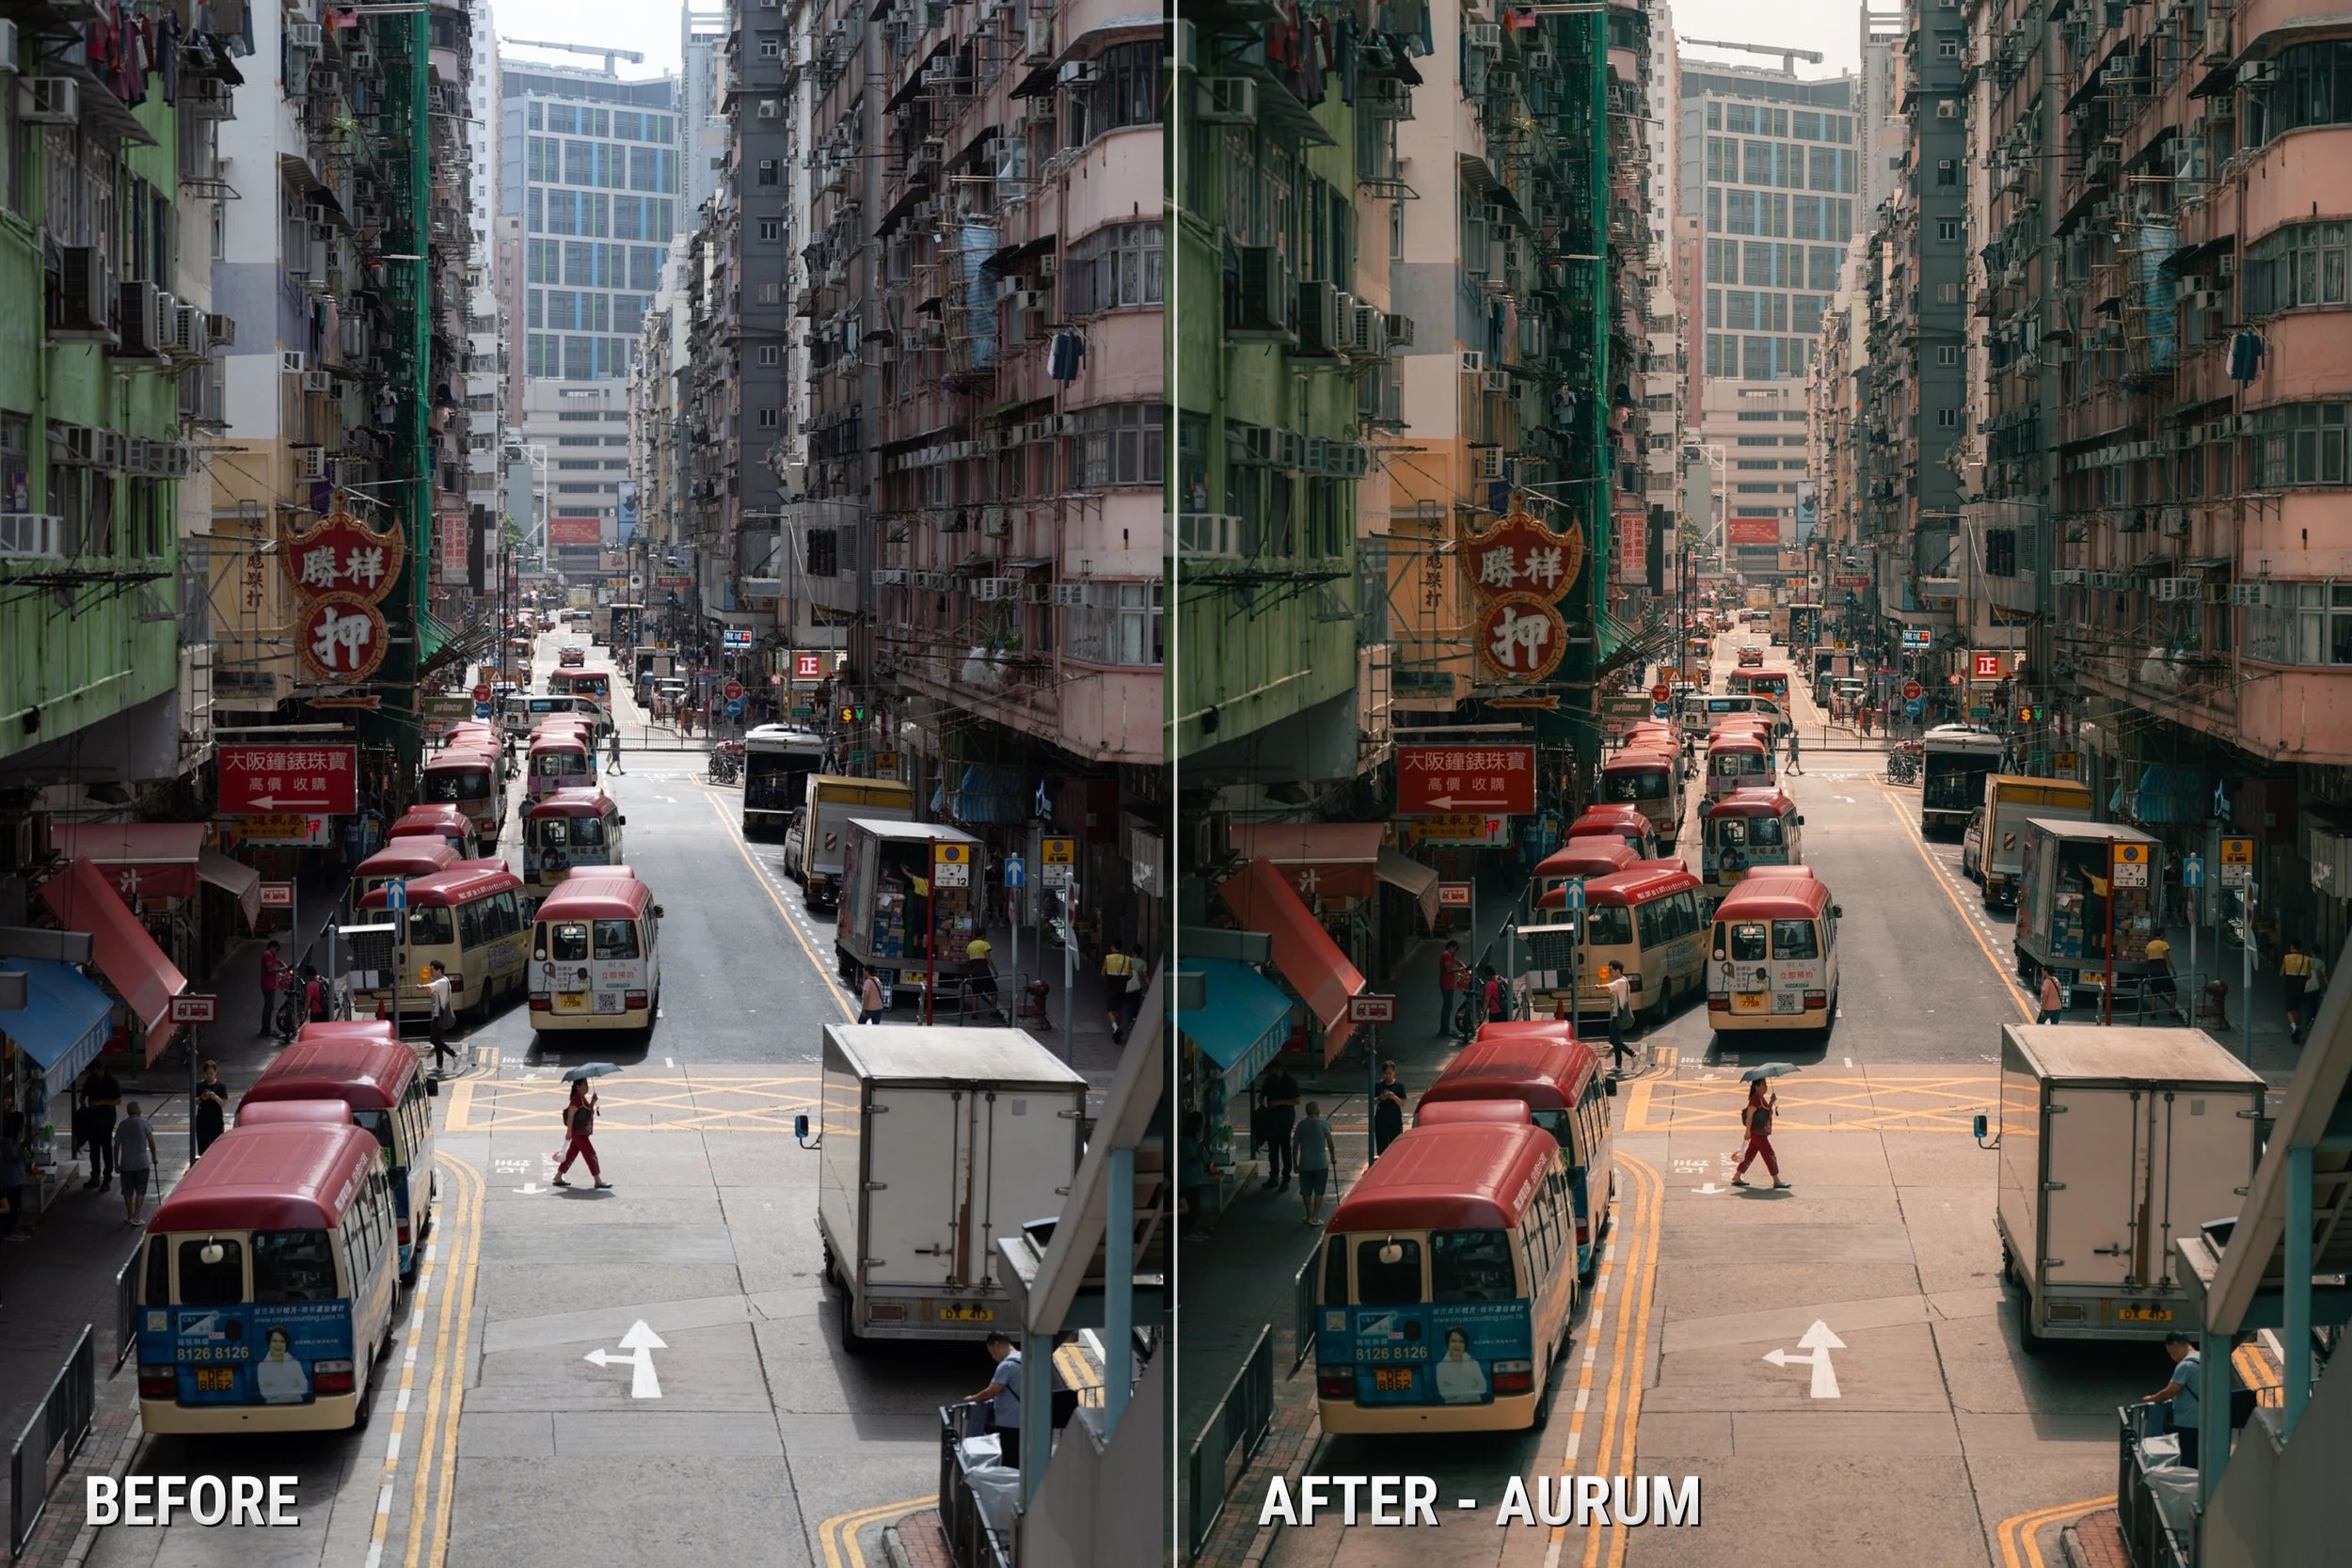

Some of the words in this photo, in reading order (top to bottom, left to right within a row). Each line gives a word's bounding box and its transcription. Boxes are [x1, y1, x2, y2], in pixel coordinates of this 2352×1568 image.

[311, 605, 373, 670] 押
[1490, 605, 1551, 670] 押
[799, 657, 818, 674] 正
[1978, 657, 1996, 674] 正
[225, 752, 348, 772] 大阪鐘錶珠寶
[1404, 752, 1527, 772] 大阪鐘錶珠寶
[956, 864, 962, 873] 7
[2135, 864, 2141, 873] 7
[119, 867, 143, 895] 汁
[1298, 867, 1322, 895] 汁
[946, 1309, 960, 1319] DX
[969, 1309, 988, 1319] 413
[2124, 1309, 2138, 1319] DX
[2148, 1309, 2167, 1319] 413
[176, 1346, 212, 1361] 8126
[214, 1345, 249, 1360] 8126
[1355, 1346, 1391, 1361] 8126
[1392, 1345, 1428, 1360] 8126
